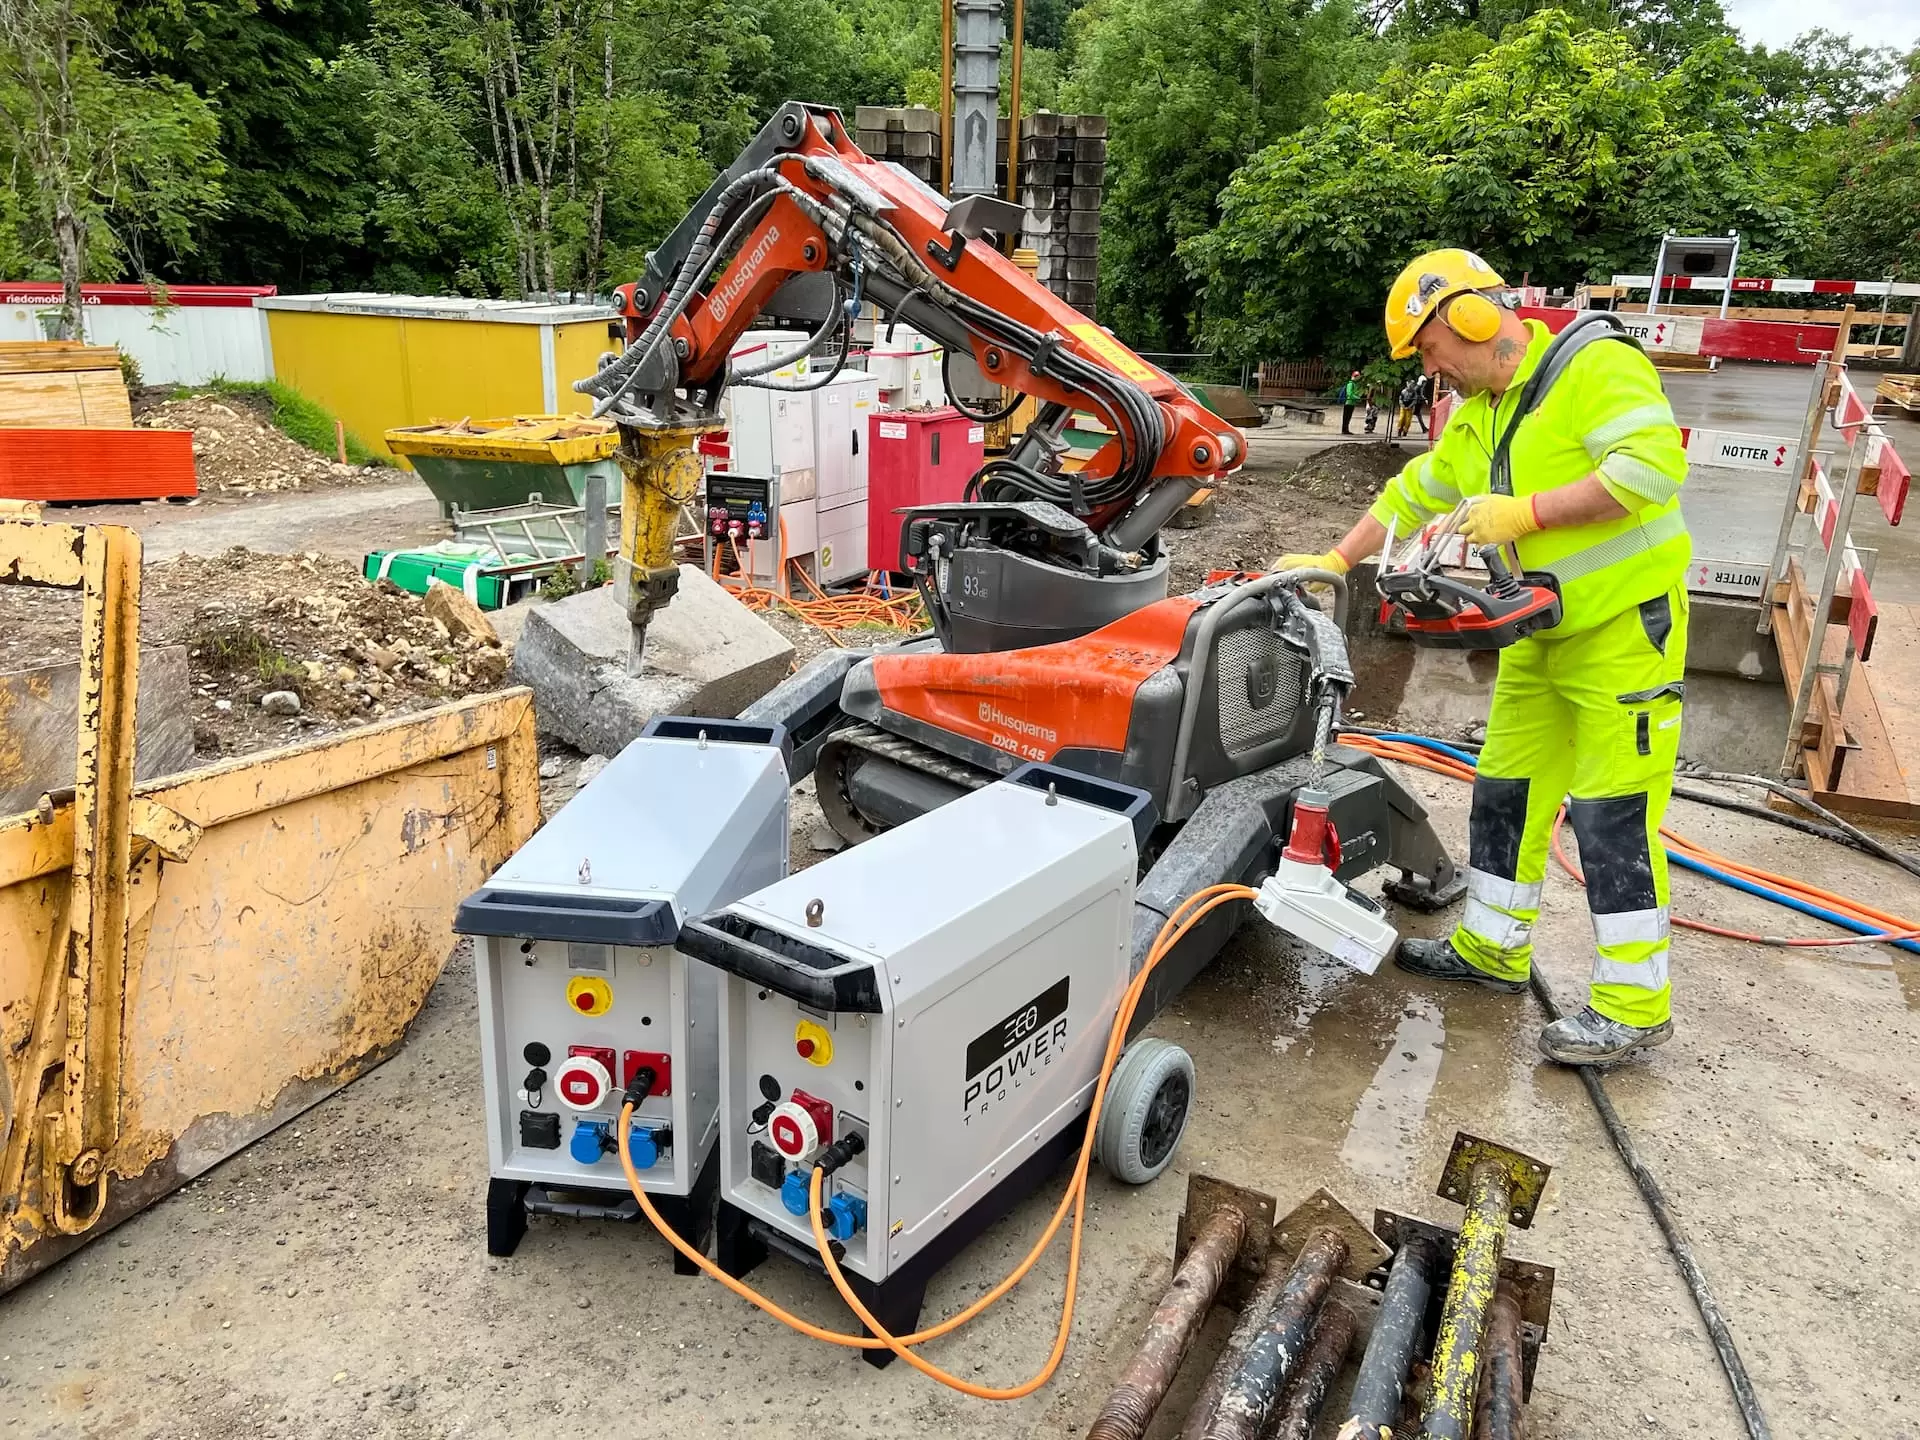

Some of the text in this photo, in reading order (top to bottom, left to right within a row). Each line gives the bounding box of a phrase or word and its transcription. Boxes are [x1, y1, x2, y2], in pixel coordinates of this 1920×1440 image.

[720, 225, 780, 306] Husqvarna
[6, 293, 101, 304] riedomobil.ch
[1624, 326, 1649, 339] TER
[1721, 445, 1769, 460] NOTTER
[1715, 571, 1761, 586] NOTTER
[991, 708, 1057, 743] Husqvarna
[991, 733, 1047, 762] DXR 145
[1003, 1005, 1038, 1049] ECO
[964, 1017, 1067, 1112] POWER
[963, 1042, 1066, 1126] TROLLEY
